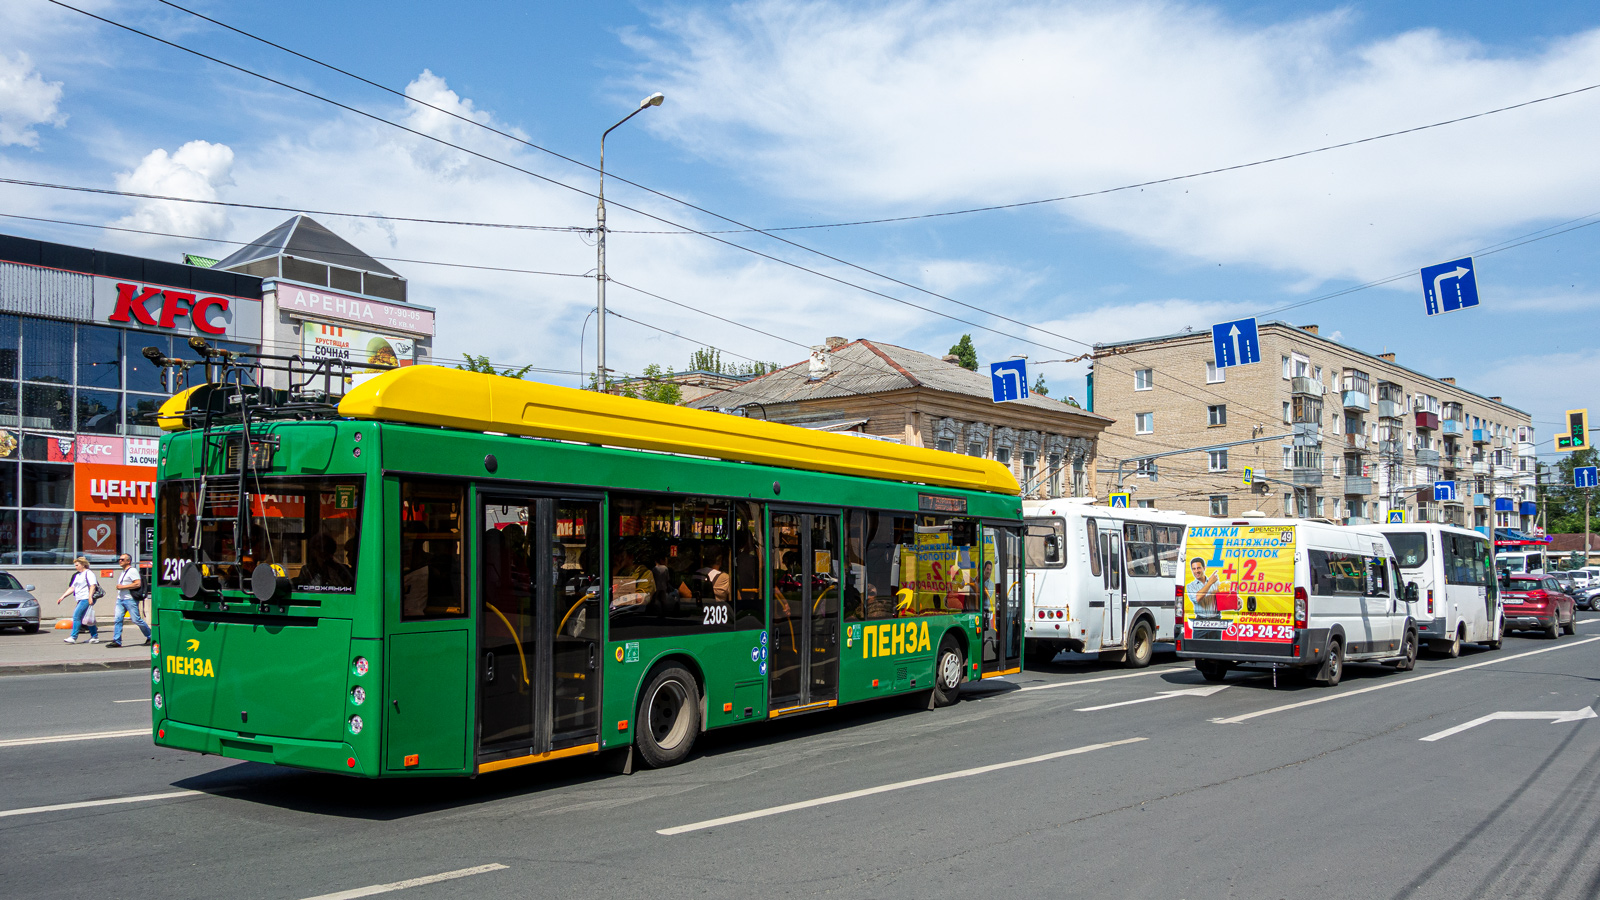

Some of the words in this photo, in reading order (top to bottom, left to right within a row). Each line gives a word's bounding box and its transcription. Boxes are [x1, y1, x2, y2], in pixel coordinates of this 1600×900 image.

[109, 283, 229, 335] KFC
[294, 291, 374, 319] АРЕНДА
[383, 306, 421, 321] 97-90-05
[388, 317, 397, 326] 76
[315, 337, 350, 348] ХРУСТЯЩАЯ
[315, 345, 350, 360] СОЧНАЯ
[1573, 424, 1583, 435] 35
[81, 443, 113, 456] KFC
[1189, 527, 1239, 537] ЗАКАЖИ
[1281, 532, 1293, 542] 49
[1207, 538, 1224, 567] 1
[1225, 549, 1280, 558] ПОТОЛОК
[163, 558, 191, 580] 230
[1242, 559, 1258, 580] 2
[1230, 581, 1292, 593] ПОДАРОК
[703, 605, 728, 625] 2303
[863, 620, 931, 659] ПЕНЗА
[1239, 625, 1294, 639] 23-24-25
[166, 655, 215, 677] ПЕНЗА
